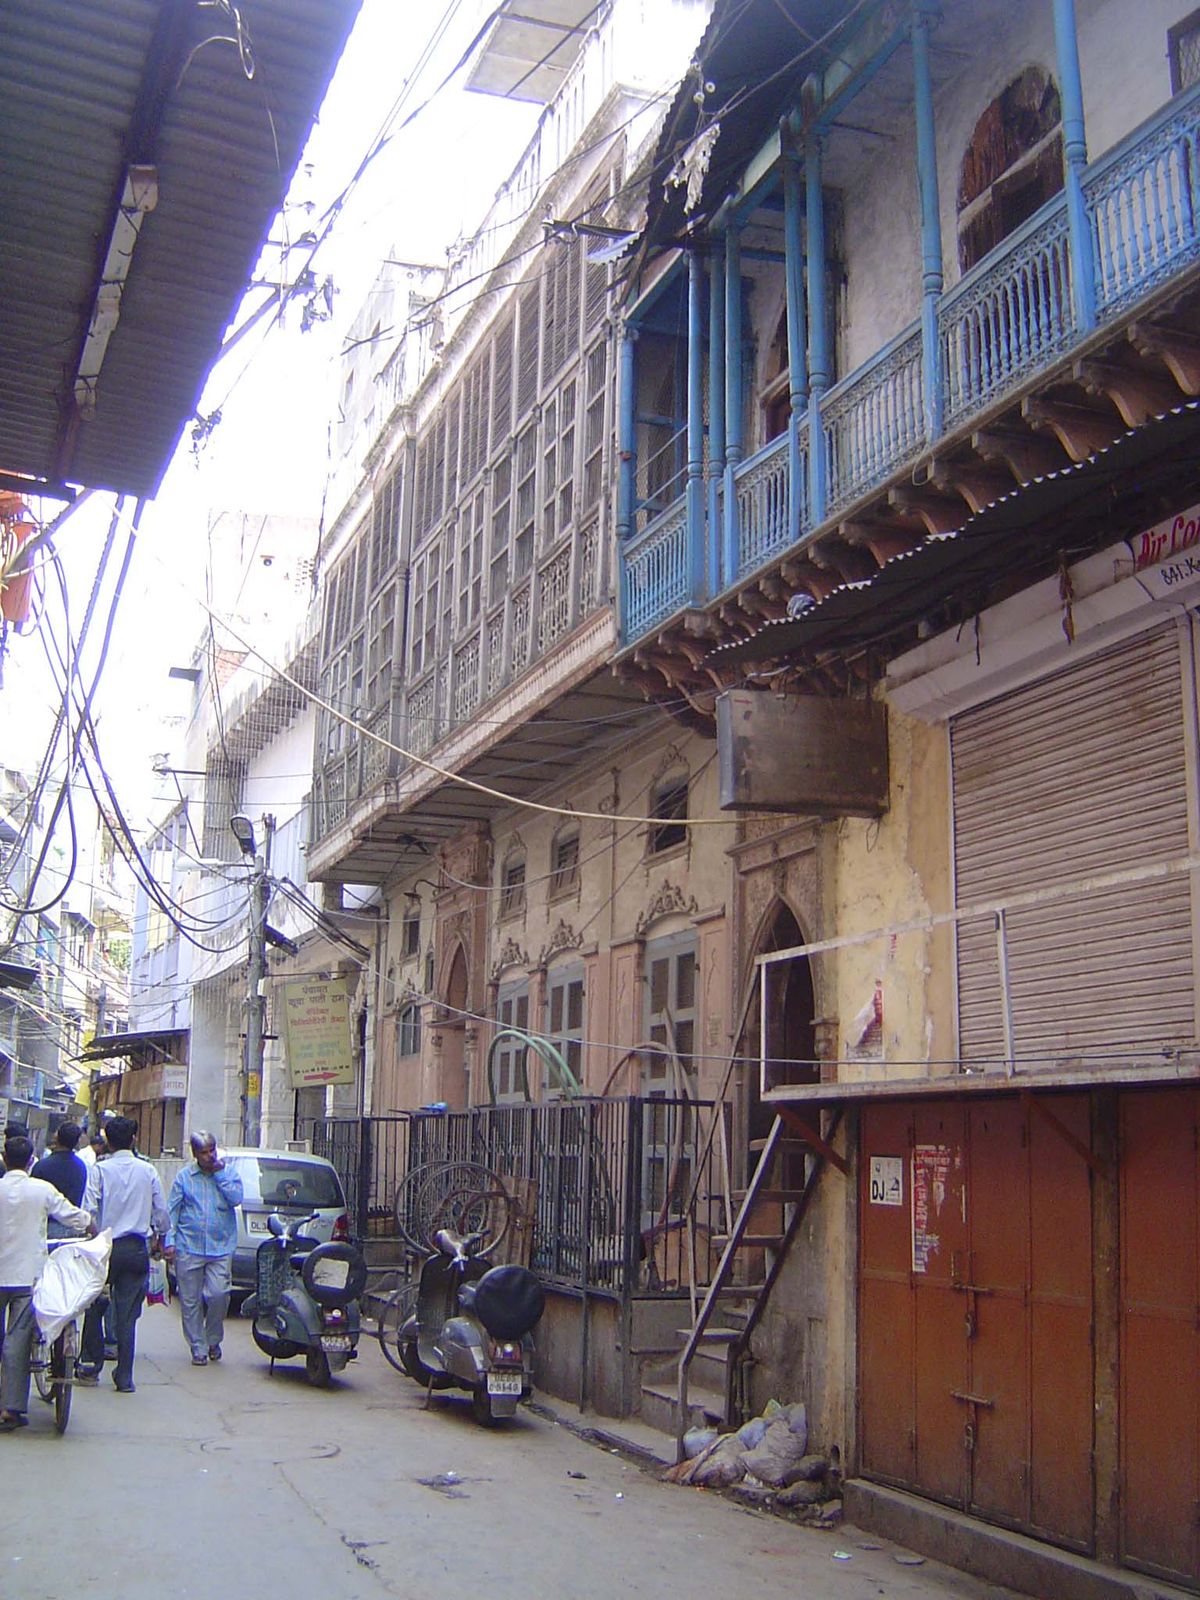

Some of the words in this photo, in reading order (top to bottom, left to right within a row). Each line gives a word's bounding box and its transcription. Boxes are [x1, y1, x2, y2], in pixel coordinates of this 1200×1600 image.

[1137, 531, 1167, 571] Air
[1171, 516, 1200, 553] Co
[872, 1180, 885, 1201] DJ
